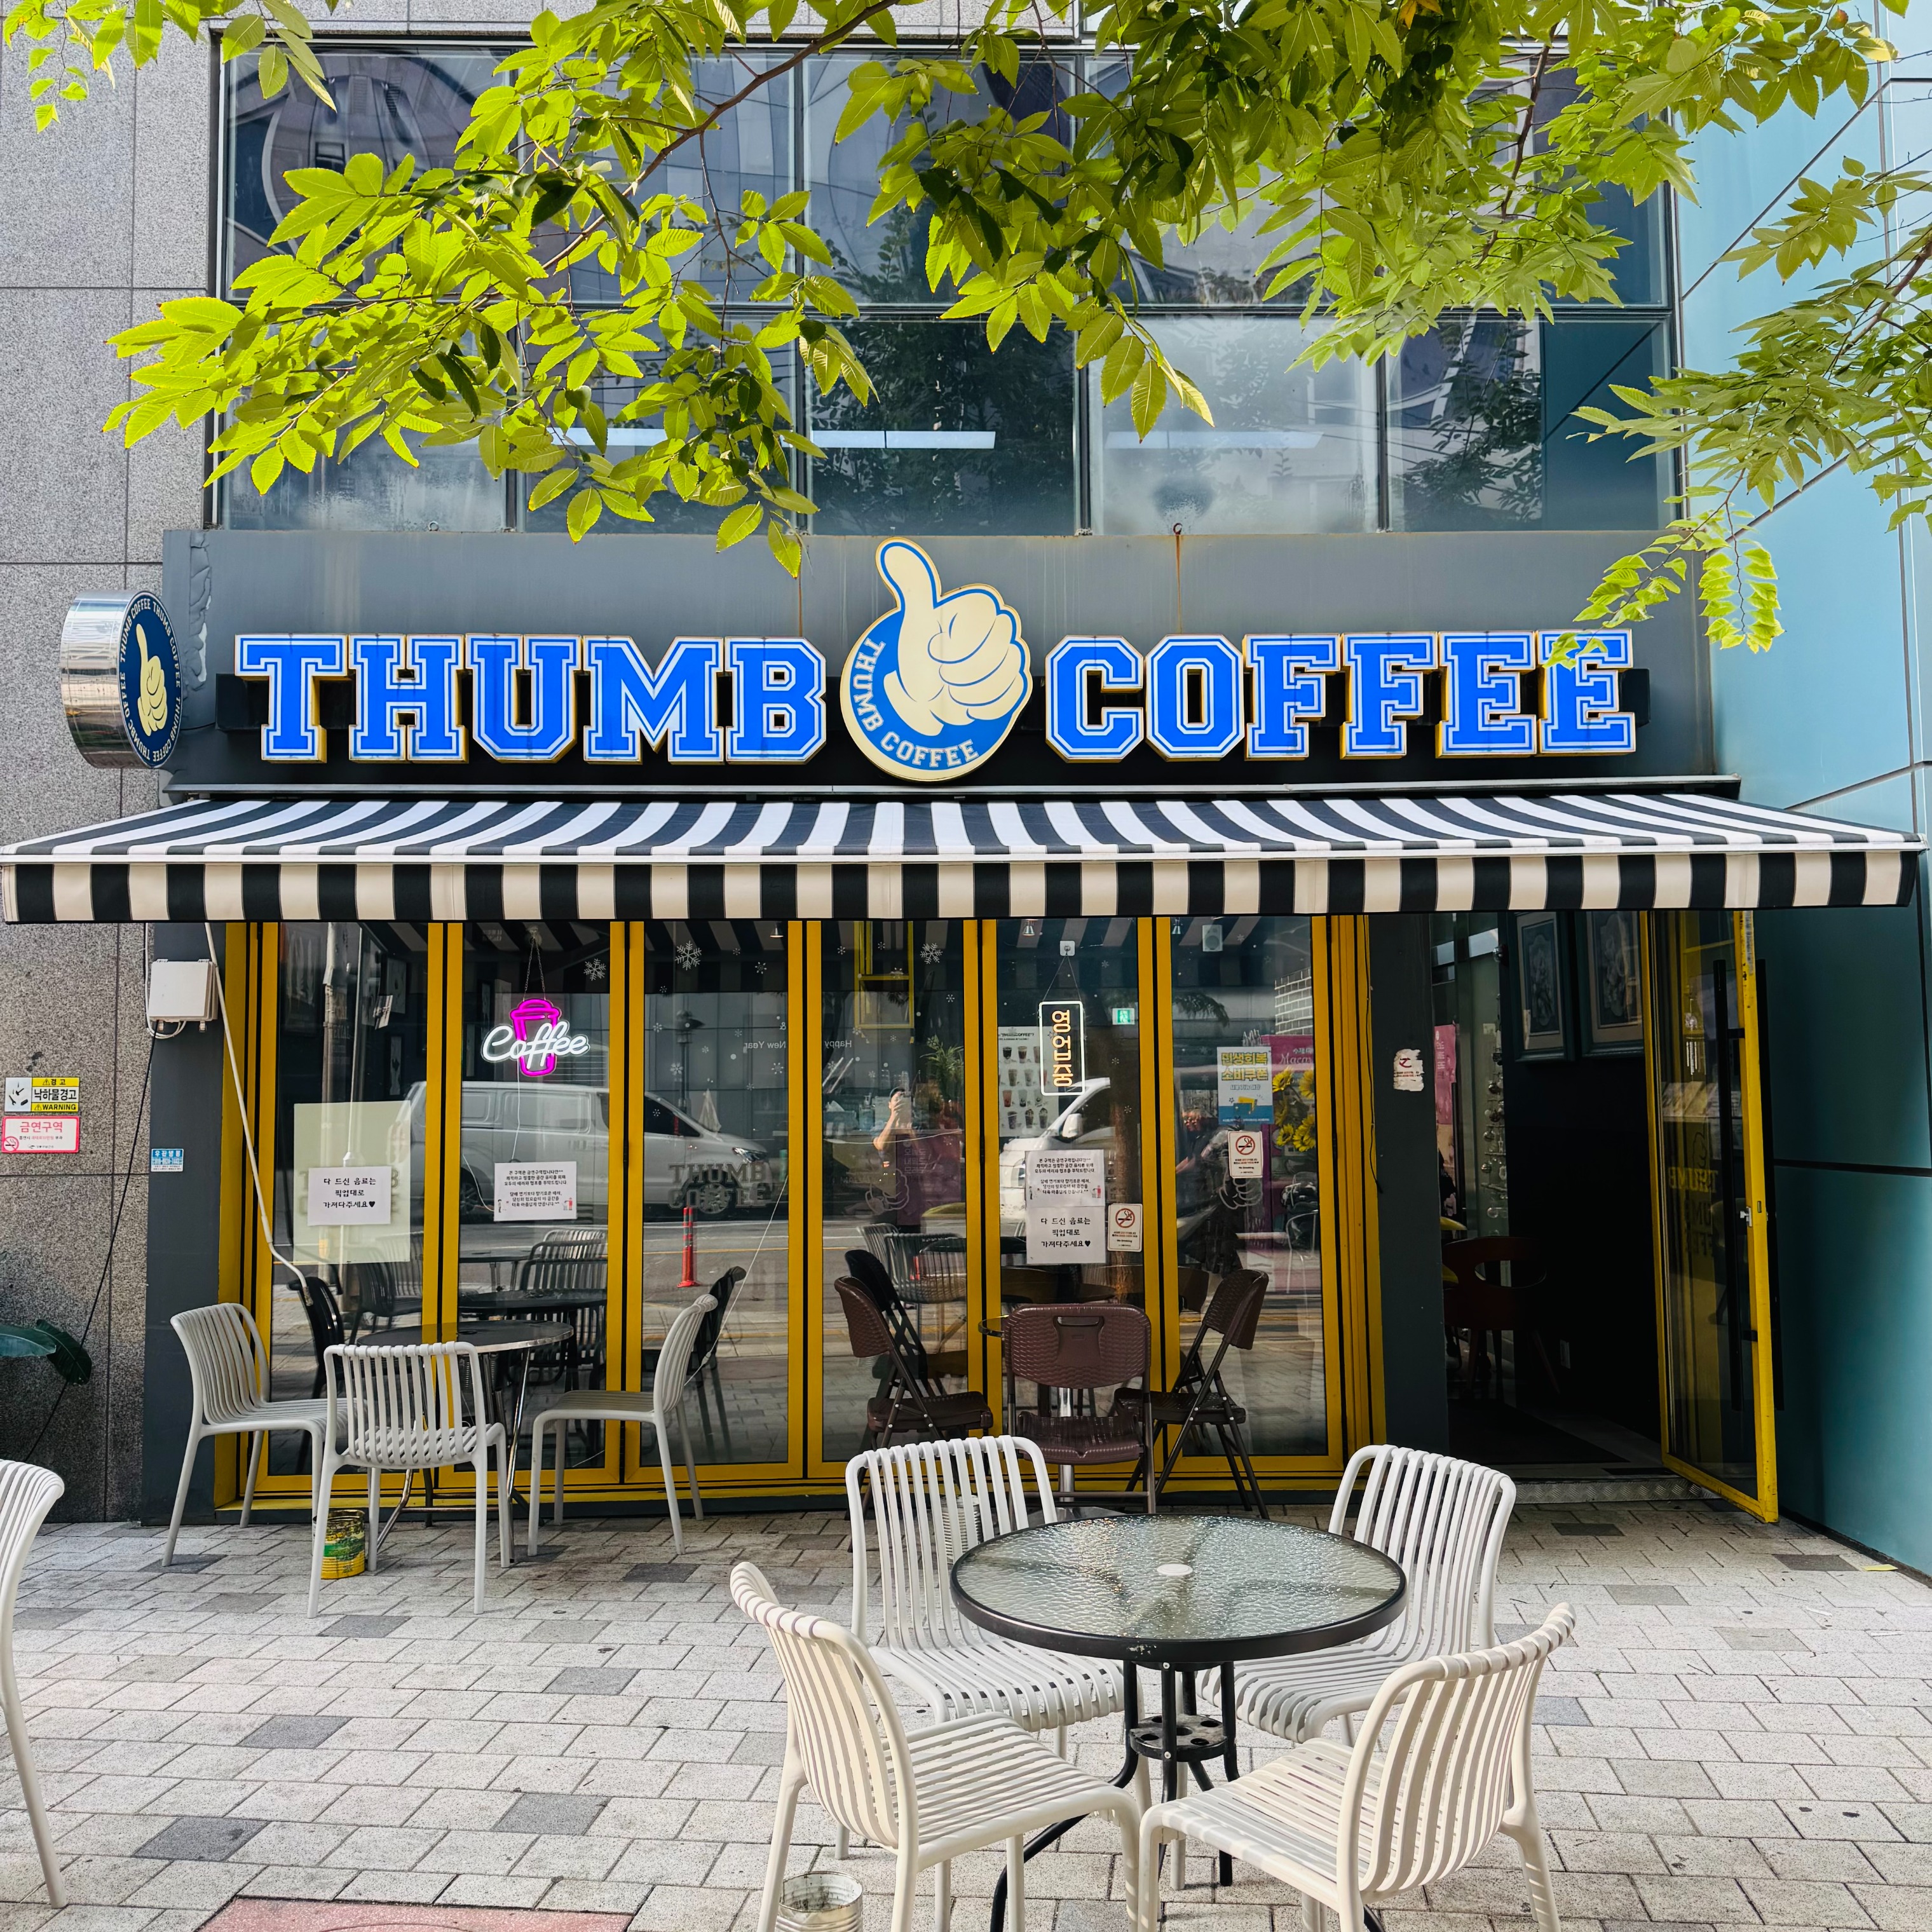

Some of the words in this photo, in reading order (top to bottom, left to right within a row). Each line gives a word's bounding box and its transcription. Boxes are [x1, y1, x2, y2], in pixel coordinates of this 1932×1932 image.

[119, 615, 132, 663] THUMB
[130, 597, 151, 617] COFFEE
[153, 601, 171, 637] THUMB
[169, 637, 181, 689] COFFEE
[235, 633, 826, 764] THUMB
[852, 637, 886, 731] THUMB
[880, 731, 979, 767] COFFEE
[1045, 629, 1636, 762] COFFEE
[170, 696, 181, 742] THUMB
[153, 742, 172, 763] COFFEE
[482, 1021, 590, 1070] Coffee
[1052, 1009, 1073, 1087] 영업중
[1221, 1052, 1268, 1066] 민생회복
[1221, 1068, 1269, 1081] 소비쿠폰
[34, 1089, 77, 1101] 낙하물경고
[20, 1122, 63, 1133] 금연구역
[334, 1178, 350, 1186] 드신
[353, 1177, 376, 1185] 음료는
[669, 1163, 766, 1185] THUMB
[335, 1189, 365, 1197] 픽업대로
[668, 1187, 766, 1210] COEE
[1069, 1217, 1091, 1225] 음료는
[1052, 1229, 1080, 1237] 픽업대로
